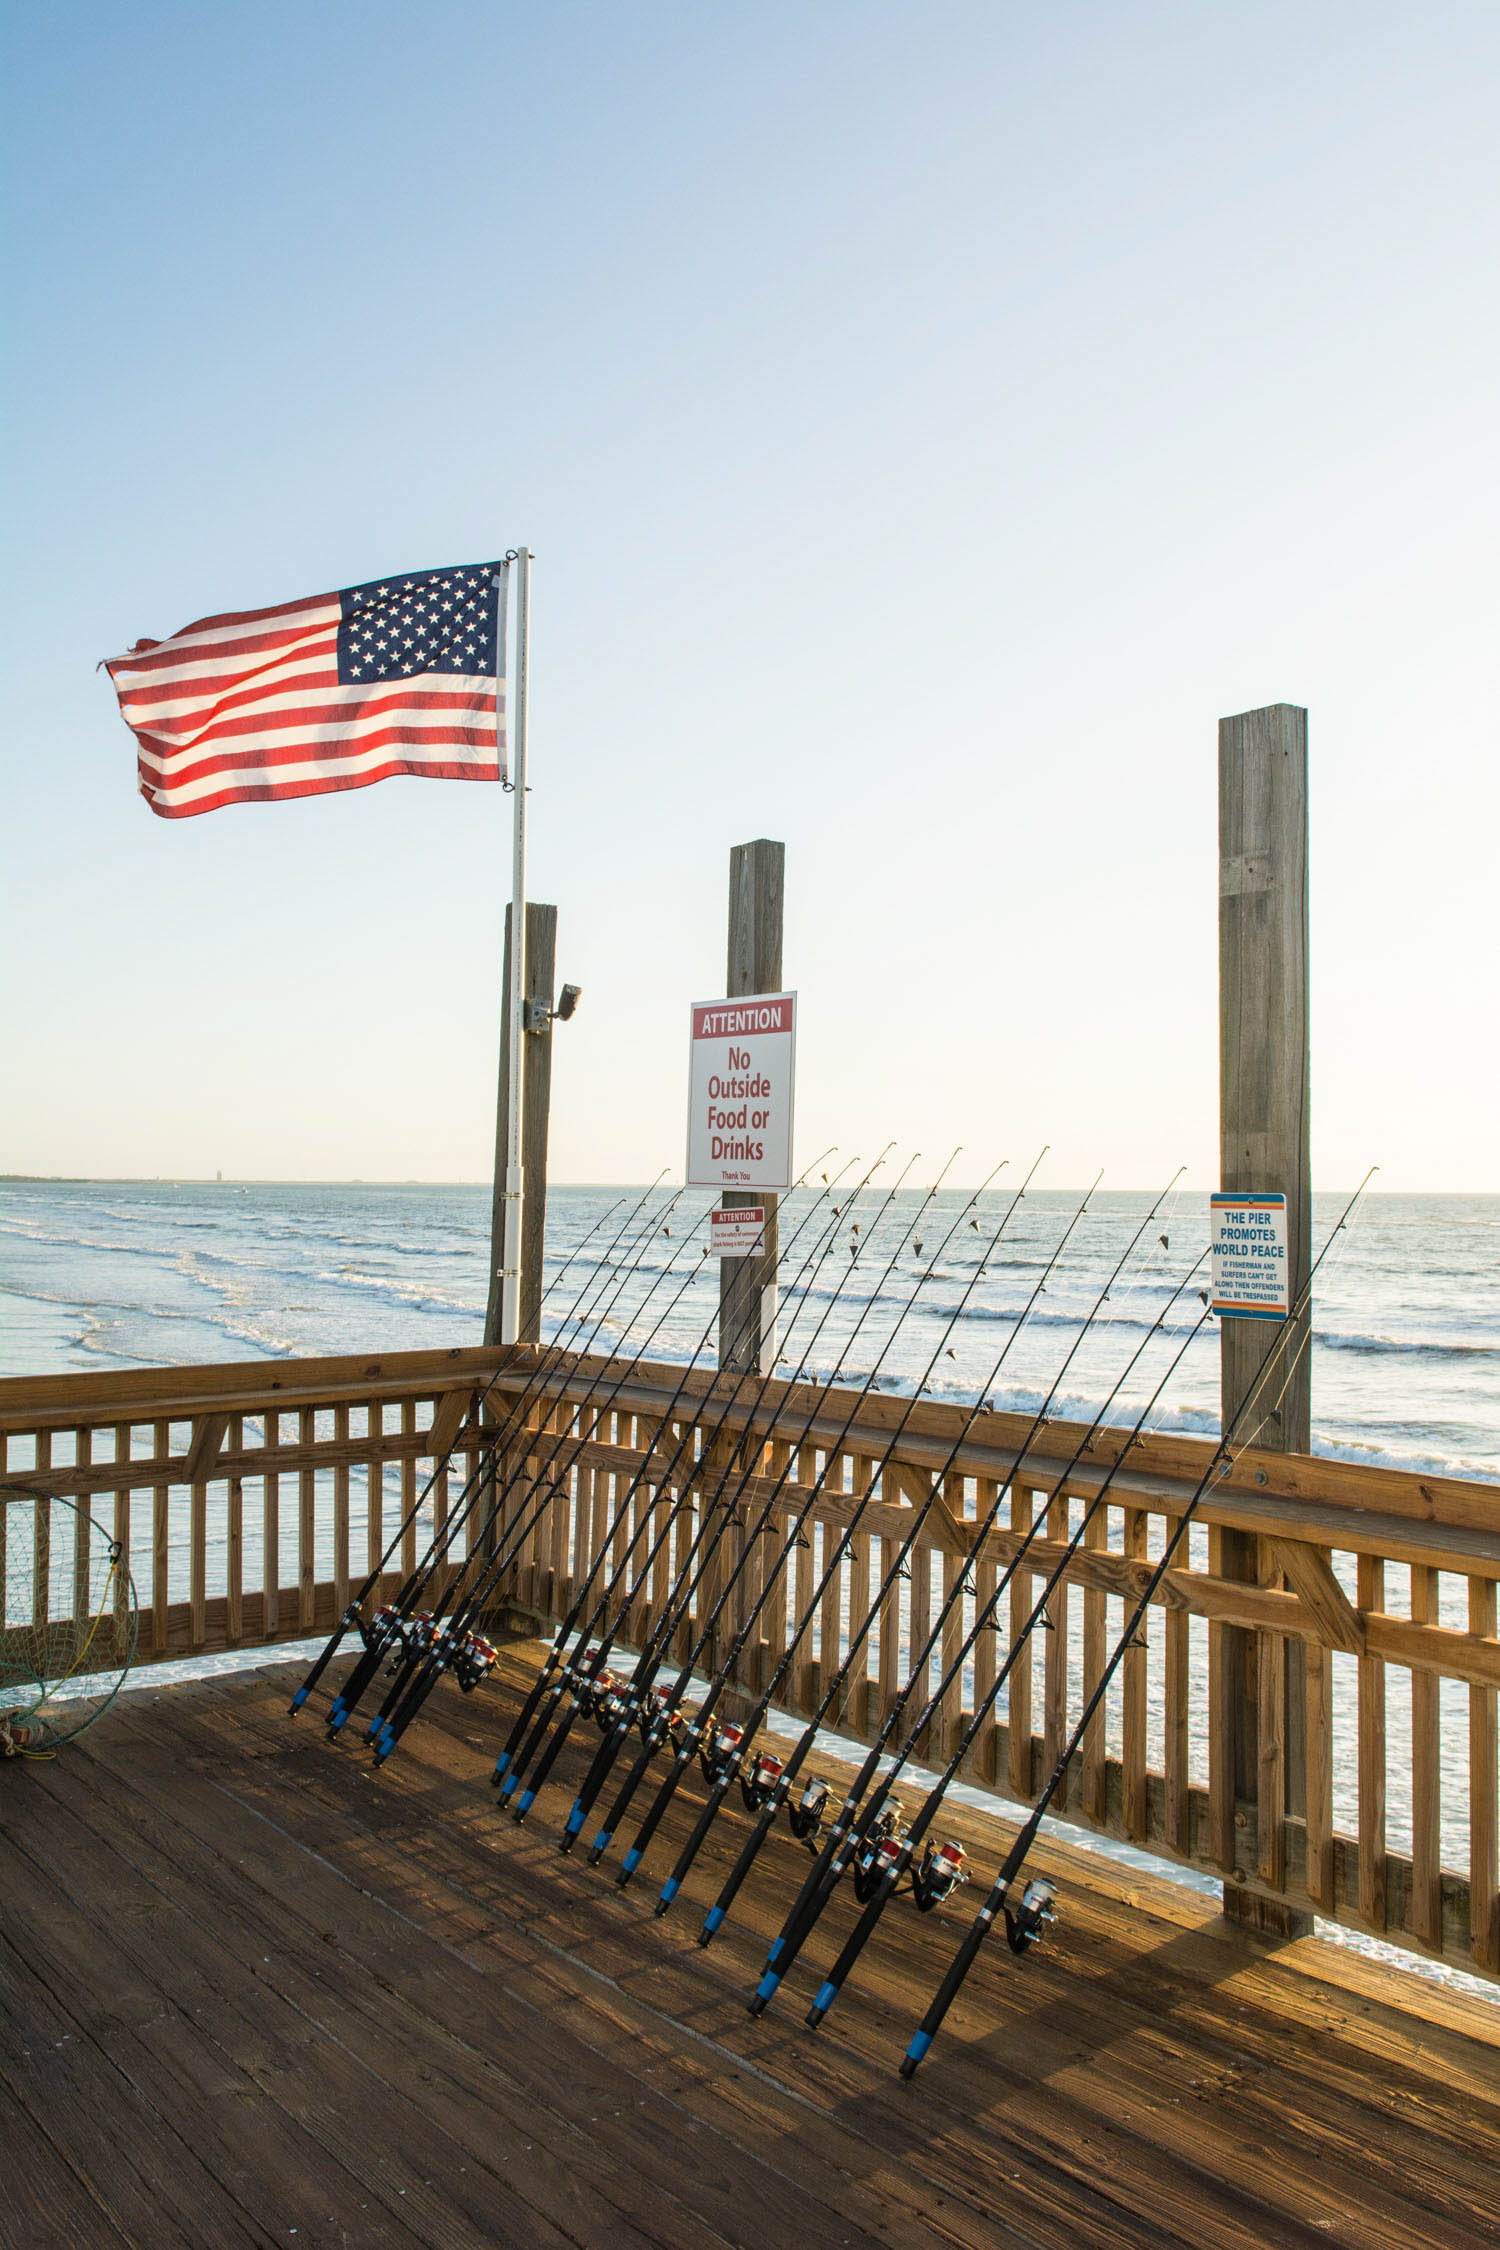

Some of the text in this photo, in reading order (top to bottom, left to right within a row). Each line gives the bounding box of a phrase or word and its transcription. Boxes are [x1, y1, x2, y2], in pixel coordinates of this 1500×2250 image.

[702, 1007, 782, 1034] ATTENTION
[728, 1046, 751, 1070] No
[708, 1072, 771, 1099] Outside
[708, 1104, 770, 1129] Food or
[711, 1135, 763, 1160] Drinks
[721, 1171, 750, 1180] Thank You
[719, 1211, 756, 1222] ATTENTION
[1224, 1212, 1271, 1224] THE PIER
[1221, 1228, 1276, 1241] PROMOTES
[1212, 1243, 1284, 1258] WORLD PEACE
[1229, 1261, 1262, 1269] FISHERMAN
[1221, 1271, 1277, 1281] SURFERS CAN'T GET
[1215, 1280, 1285, 1291] ALONG THEN OFFENDERS
[1219, 1290, 1232, 1298] WILL
[1243, 1292, 1278, 1301] TRESPASSED
